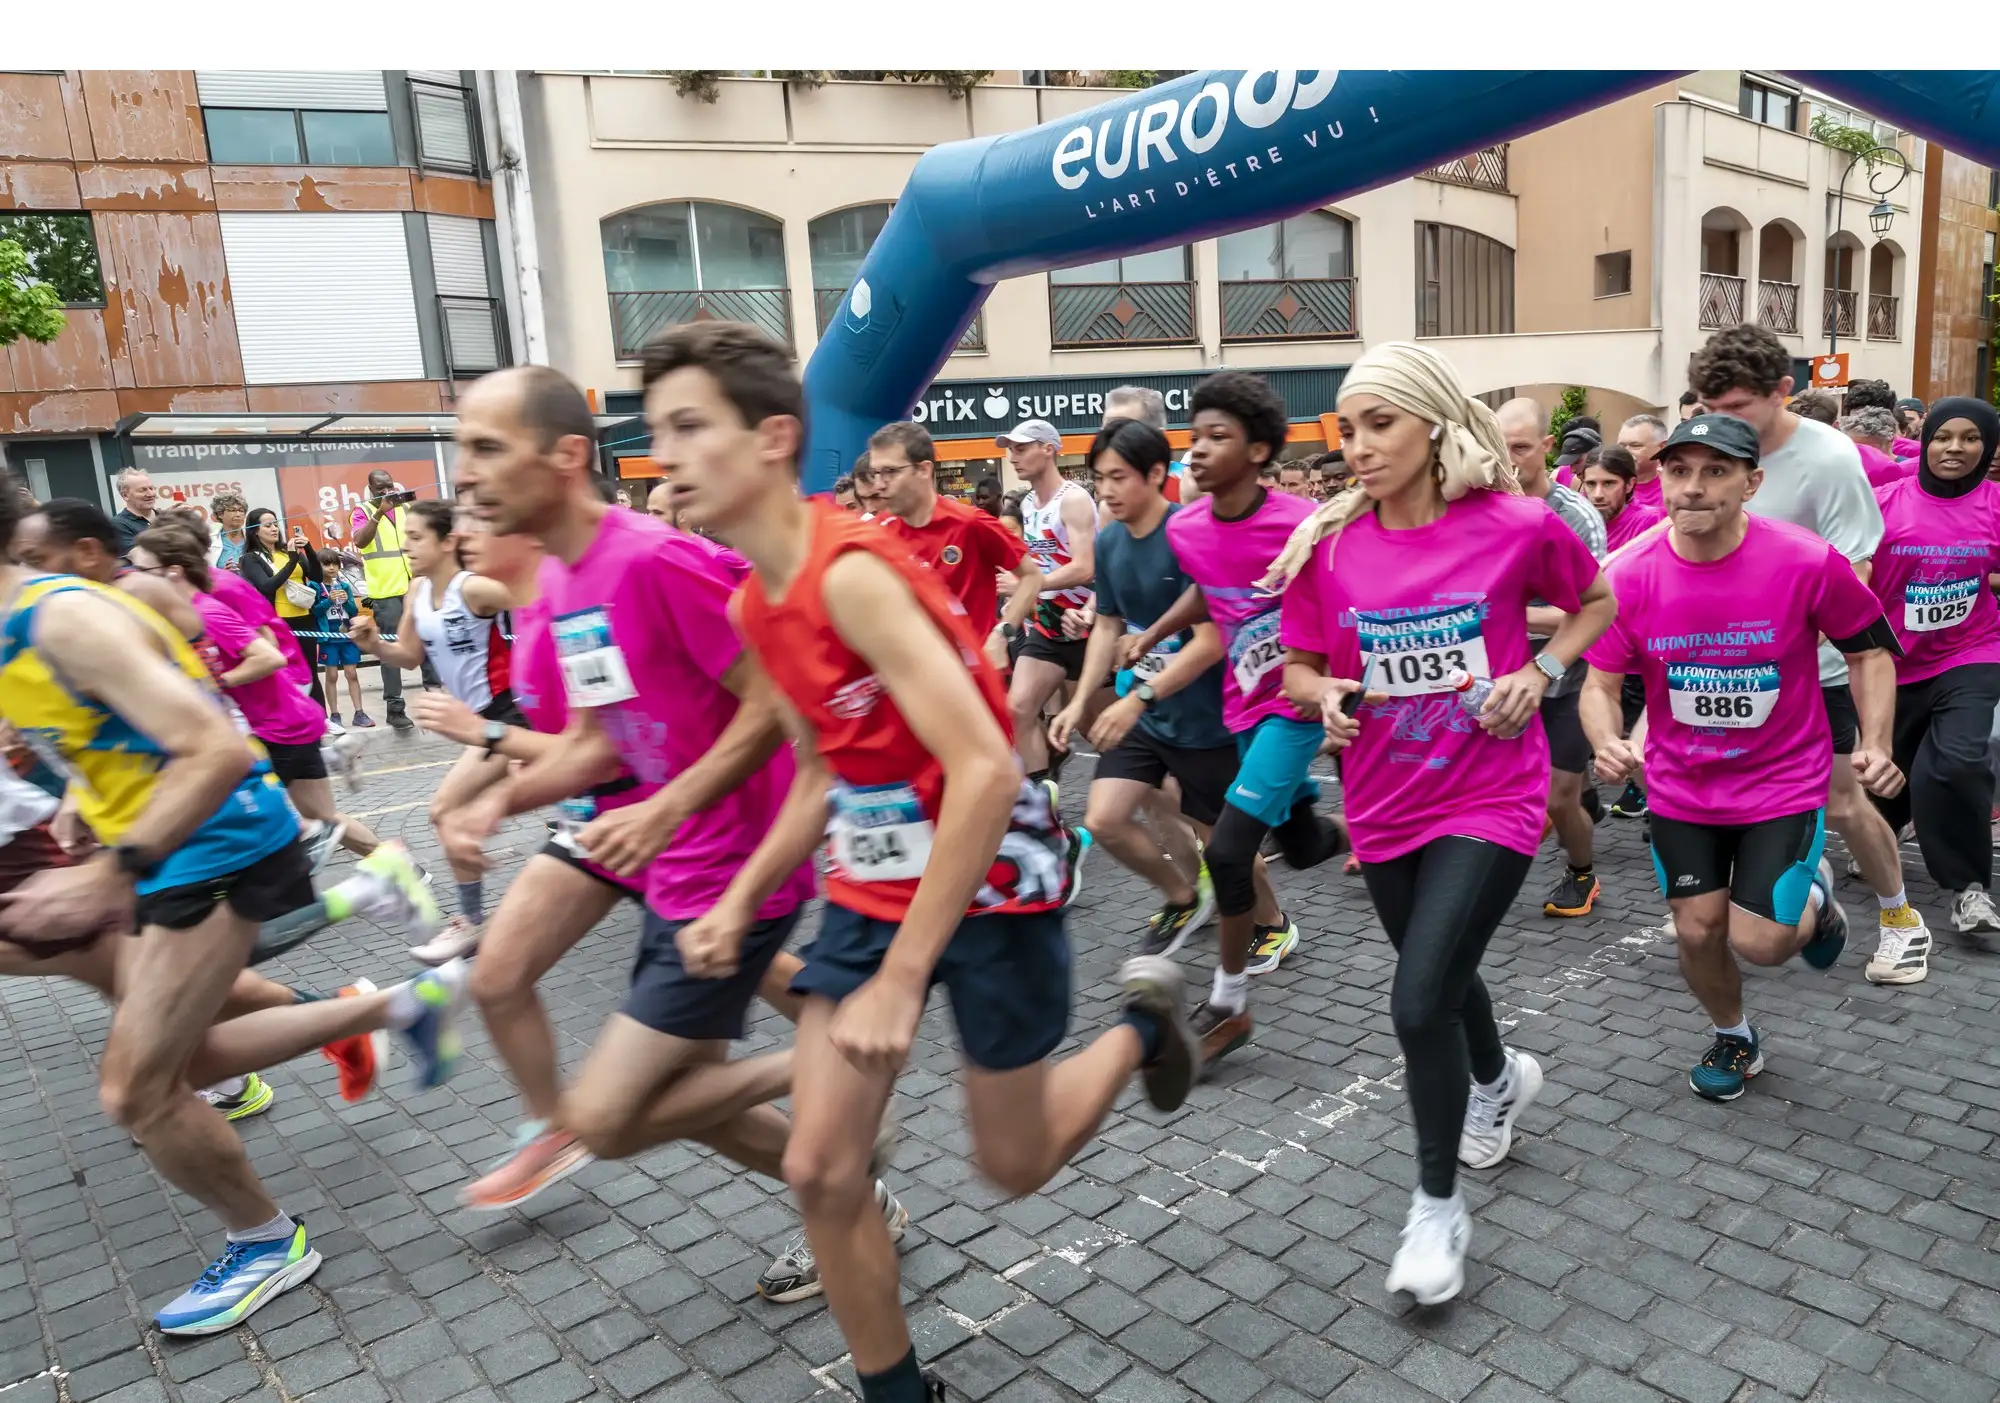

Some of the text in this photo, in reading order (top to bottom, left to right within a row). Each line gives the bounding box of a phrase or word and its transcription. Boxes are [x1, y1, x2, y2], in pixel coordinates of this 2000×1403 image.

[1085, 188, 1156, 218] L'ART
[1175, 146, 1283, 196] D'ÊTRE
[1303, 120, 1344, 148] VU
[155, 481, 243, 499] ourses
[1915, 600, 1968, 624] 1025
[1379, 649, 1468, 685] 1033
[1668, 665, 1776, 680] LA FONTENAISIENNE
[1694, 695, 1753, 718] 886
